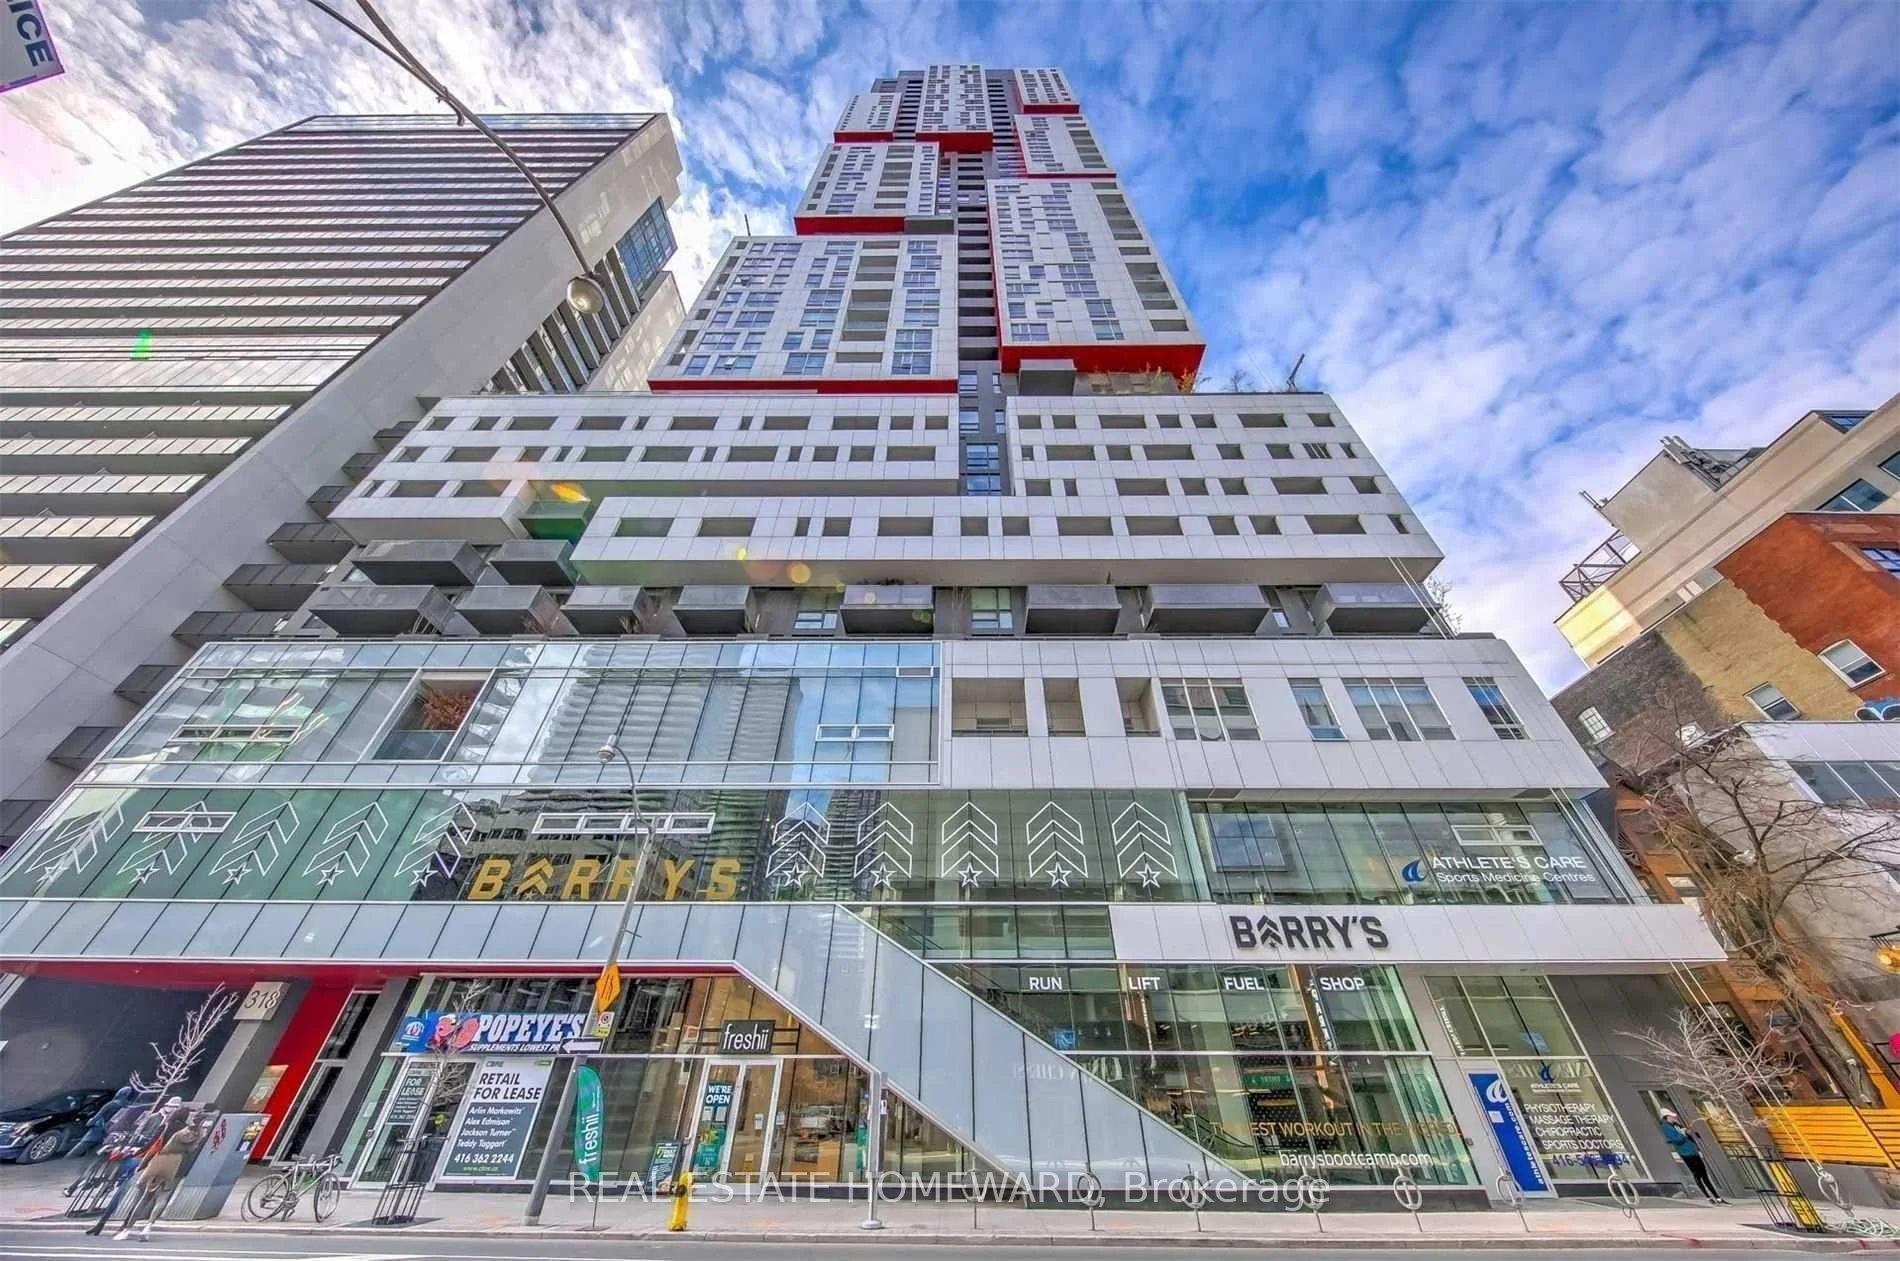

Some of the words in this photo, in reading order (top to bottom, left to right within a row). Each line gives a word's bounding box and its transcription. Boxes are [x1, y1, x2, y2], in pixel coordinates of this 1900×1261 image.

[7, 0, 54, 67] ICE
[1432, 856, 1530, 869] ATHLETE'S
[1534, 856, 1587, 869] CARE
[1436, 872, 1479, 884] Sports
[1481, 872, 1540, 883] Medicine
[1544, 872, 1596, 883] Centres
[1229, 915, 1389, 950] BARRY'S
[1029, 977, 1063, 990] RUN
[1128, 976, 1161, 990] LIFT
[1224, 976, 1265, 990] FUEL
[1320, 977, 1365, 990] SHOP
[244, 990, 280, 1010] 318
[474, 1014, 587, 1042] POPEYE'S
[722, 1023, 770, 1051] freshii
[479, 1073, 520, 1085] RETAIL
[473, 1087, 501, 1100] FOR
[503, 1087, 542, 1100] LEASE
[706, 1095, 731, 1104] OPEN
[1523, 1103, 1596, 1113] PHYSIOTHERAPY
[1528, 1114, 1573, 1125] MASSAGE
[1574, 1114, 1614, 1125] THERAPY
[1279, 1121, 1353, 1137] WORKOUT
[1535, 1127, 1602, 1137] CHIROPRACTIC
[579, 1113, 599, 1165] freshii
[1542, 1139, 1579, 1150] SPORTS
[1580, 1139, 1625, 1150] DOCTORS
[454, 1153, 471, 1163] 416
[1279, 1150, 1432, 1168] barrysbootcamp.com
